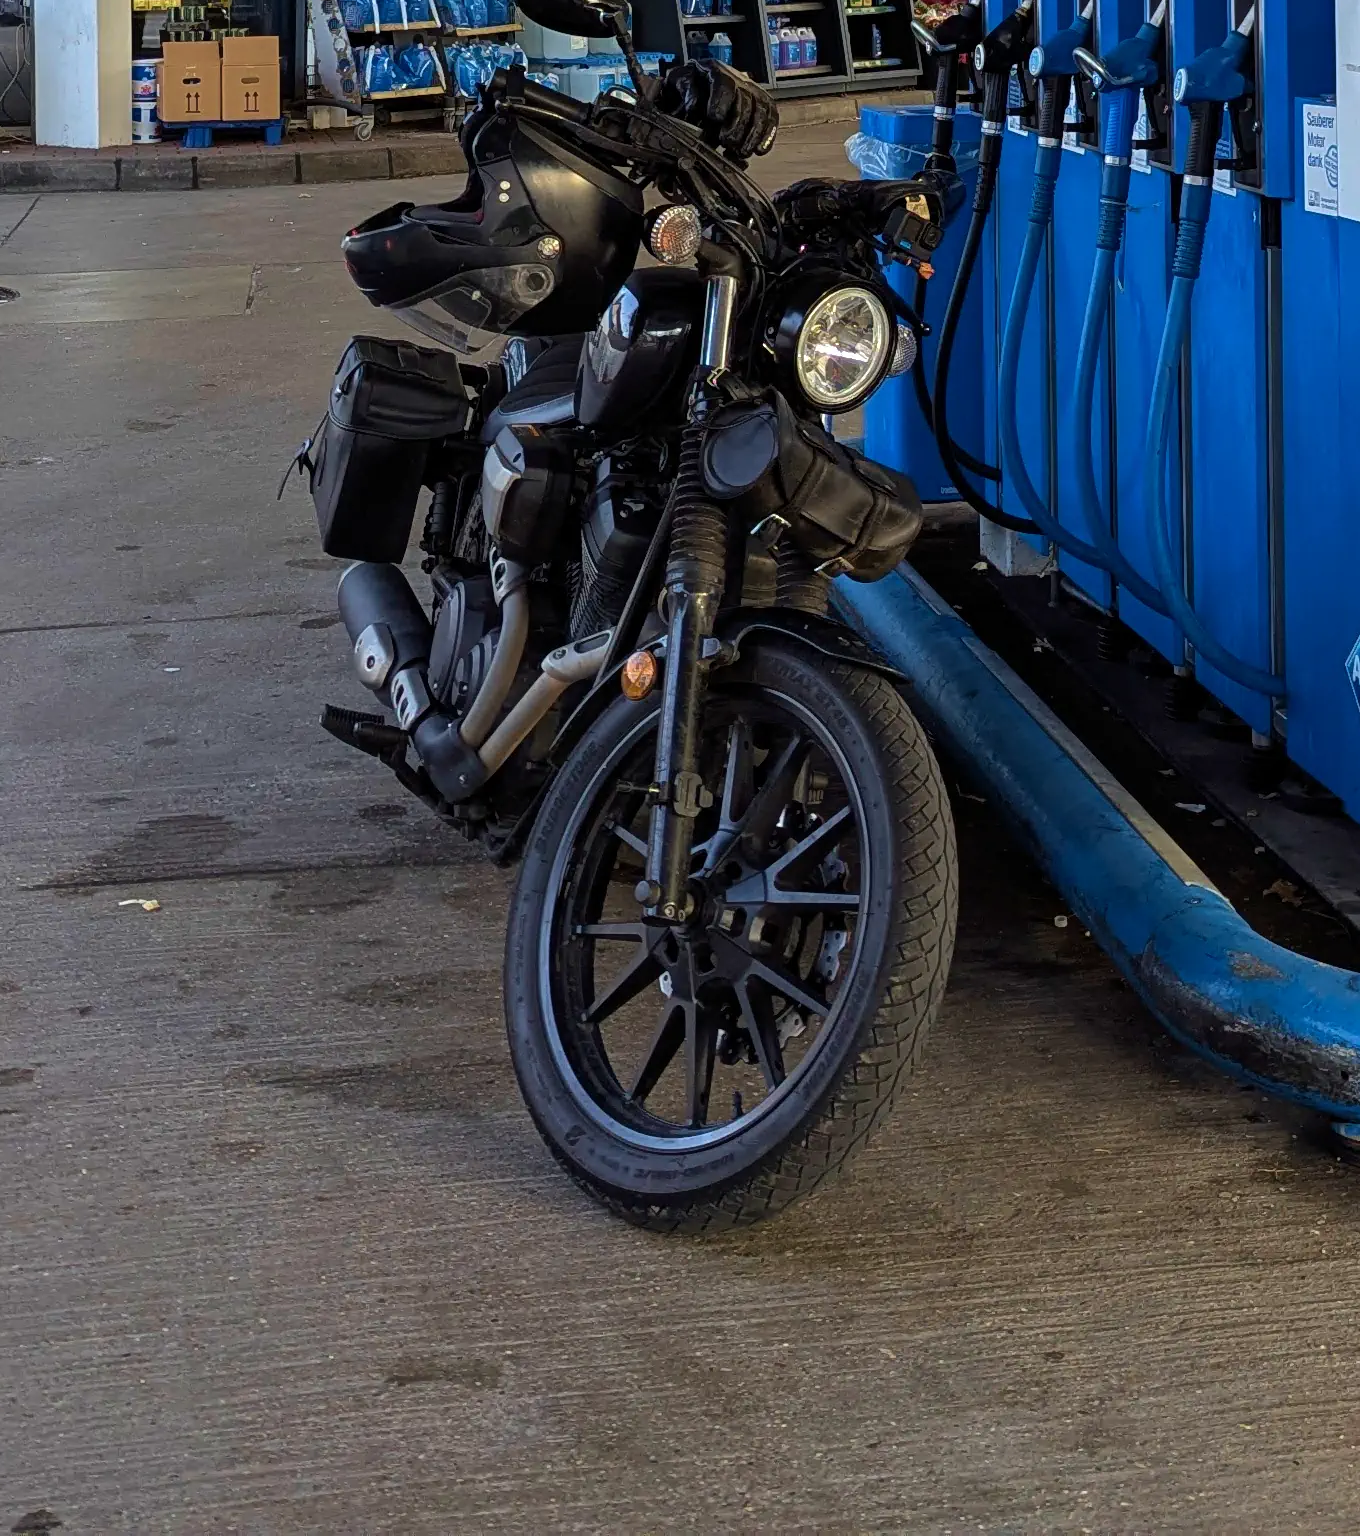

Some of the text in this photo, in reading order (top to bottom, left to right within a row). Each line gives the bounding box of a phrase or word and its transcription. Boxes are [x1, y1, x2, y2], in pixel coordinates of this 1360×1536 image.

[1306, 111, 1335, 129] Sauberer
[1307, 131, 1326, 148] Motor
[1307, 152, 1324, 169] dank
